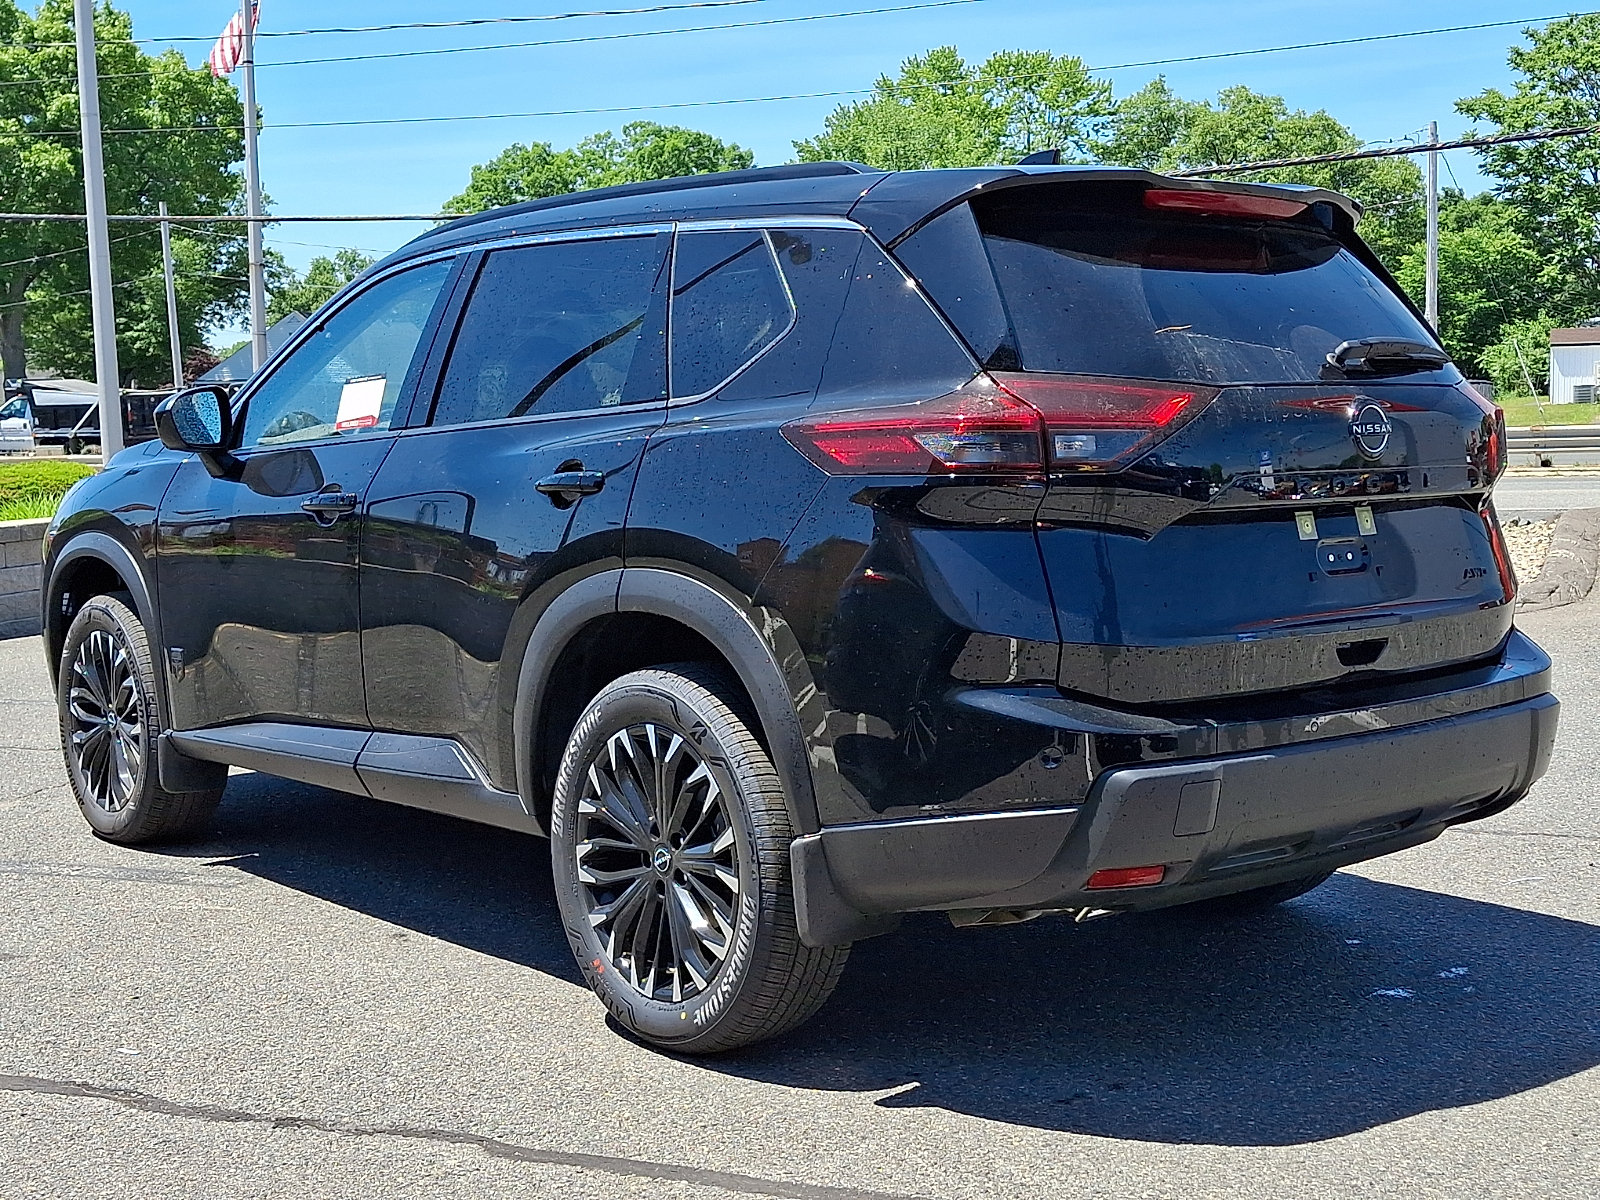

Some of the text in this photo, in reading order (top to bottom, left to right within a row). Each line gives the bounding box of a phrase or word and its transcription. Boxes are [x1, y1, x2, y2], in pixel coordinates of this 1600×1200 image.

[1352, 424, 1392, 434] NISSAN
[552, 704, 602, 839] BRIDGESTONE
[574, 945, 624, 1019] ALENZA
[693, 892, 757, 1027] BRIDGESTONE
